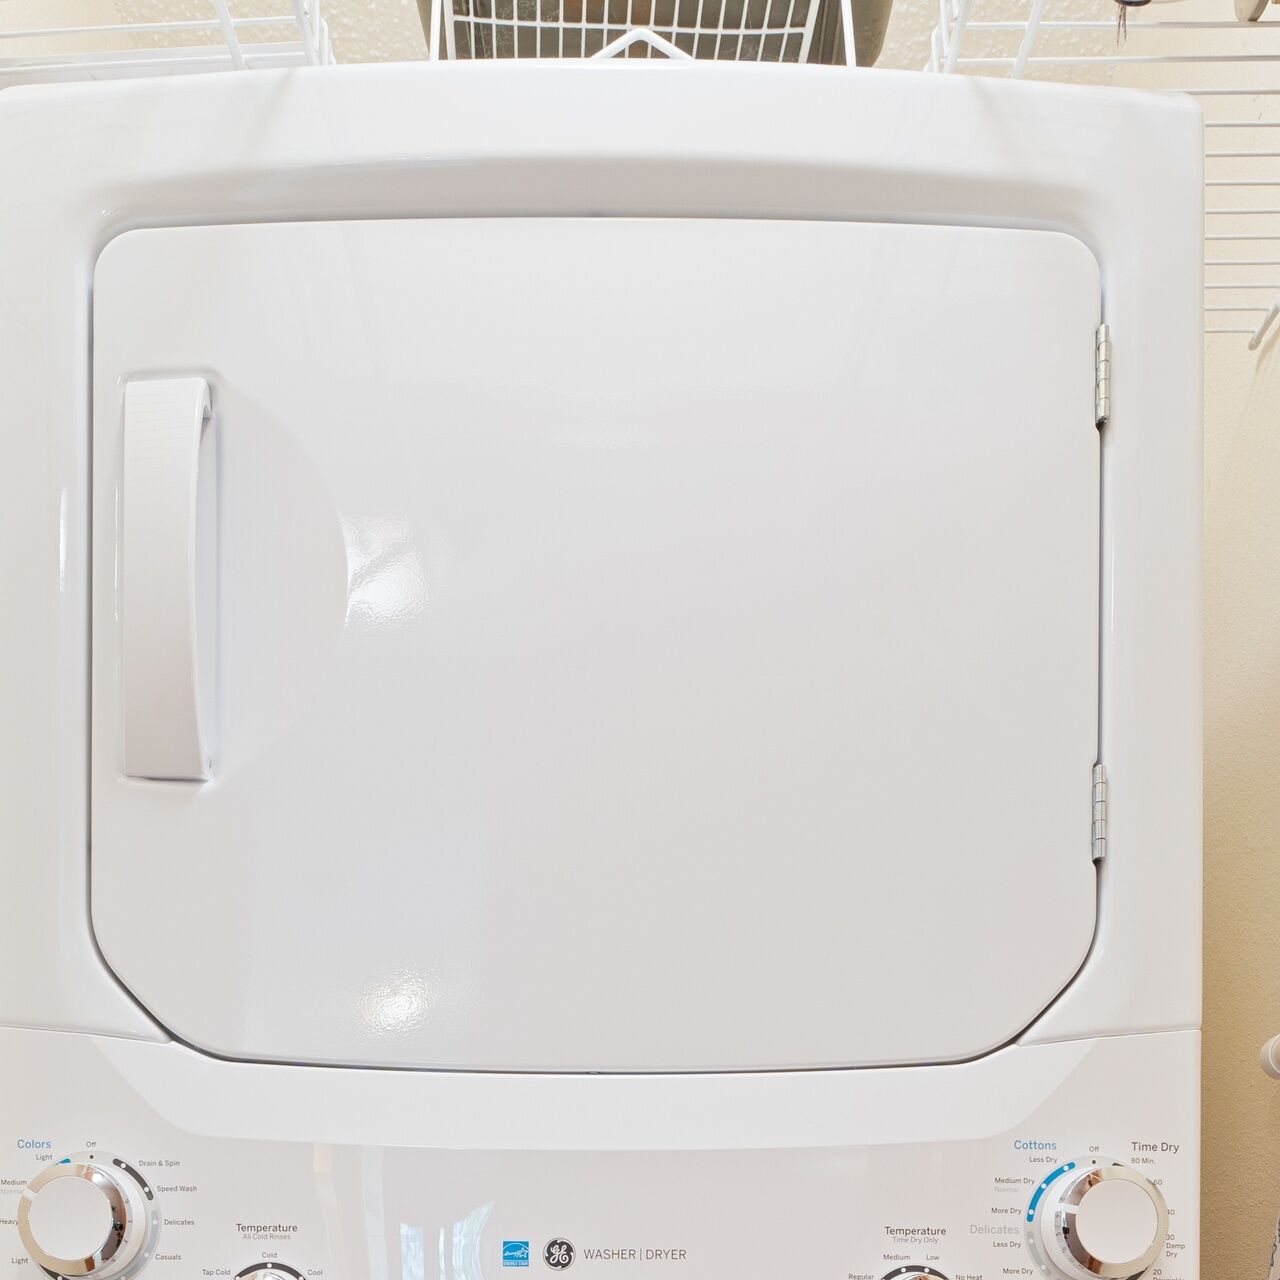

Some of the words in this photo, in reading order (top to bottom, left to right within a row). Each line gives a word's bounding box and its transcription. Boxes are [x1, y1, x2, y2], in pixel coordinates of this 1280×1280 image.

[17, 1139, 52, 1150] Colors
[1014, 1140, 1057, 1151] Cottons
[1131, 1142, 1158, 1152] Time
[1159, 1142, 1179, 1154] Dry
[35, 1153, 53, 1162] Light
[1046, 1156, 1058, 1165] Dry
[165, 1160, 180, 1168] Spin
[1023, 1177, 1035, 1186] Dry
[157, 1185, 175, 1193] Speed
[1010, 1207, 1022, 1216] Dry
[236, 1223, 297, 1233] Temperature
[885, 1226, 946, 1237] Temperature
[969, 1224, 1019, 1234] Delicates
[909, 1237, 920, 1245] Dry
[922, 1237, 939, 1245] Only
[1010, 1241, 1022, 1249] Dry
[1166, 1242, 1186, 1250] Damp
[155, 1253, 181, 1261] Casuals
[584, 1249, 636, 1260] WASHER
[645, 1249, 687, 1260] DRYER
[1166, 1251, 1177, 1259] Dry
[11, 1257, 28, 1265] Light
[202, 1269, 214, 1278] Tap
[848, 1273, 874, 1280] Regular
[1021, 1268, 1033, 1276] Dry
